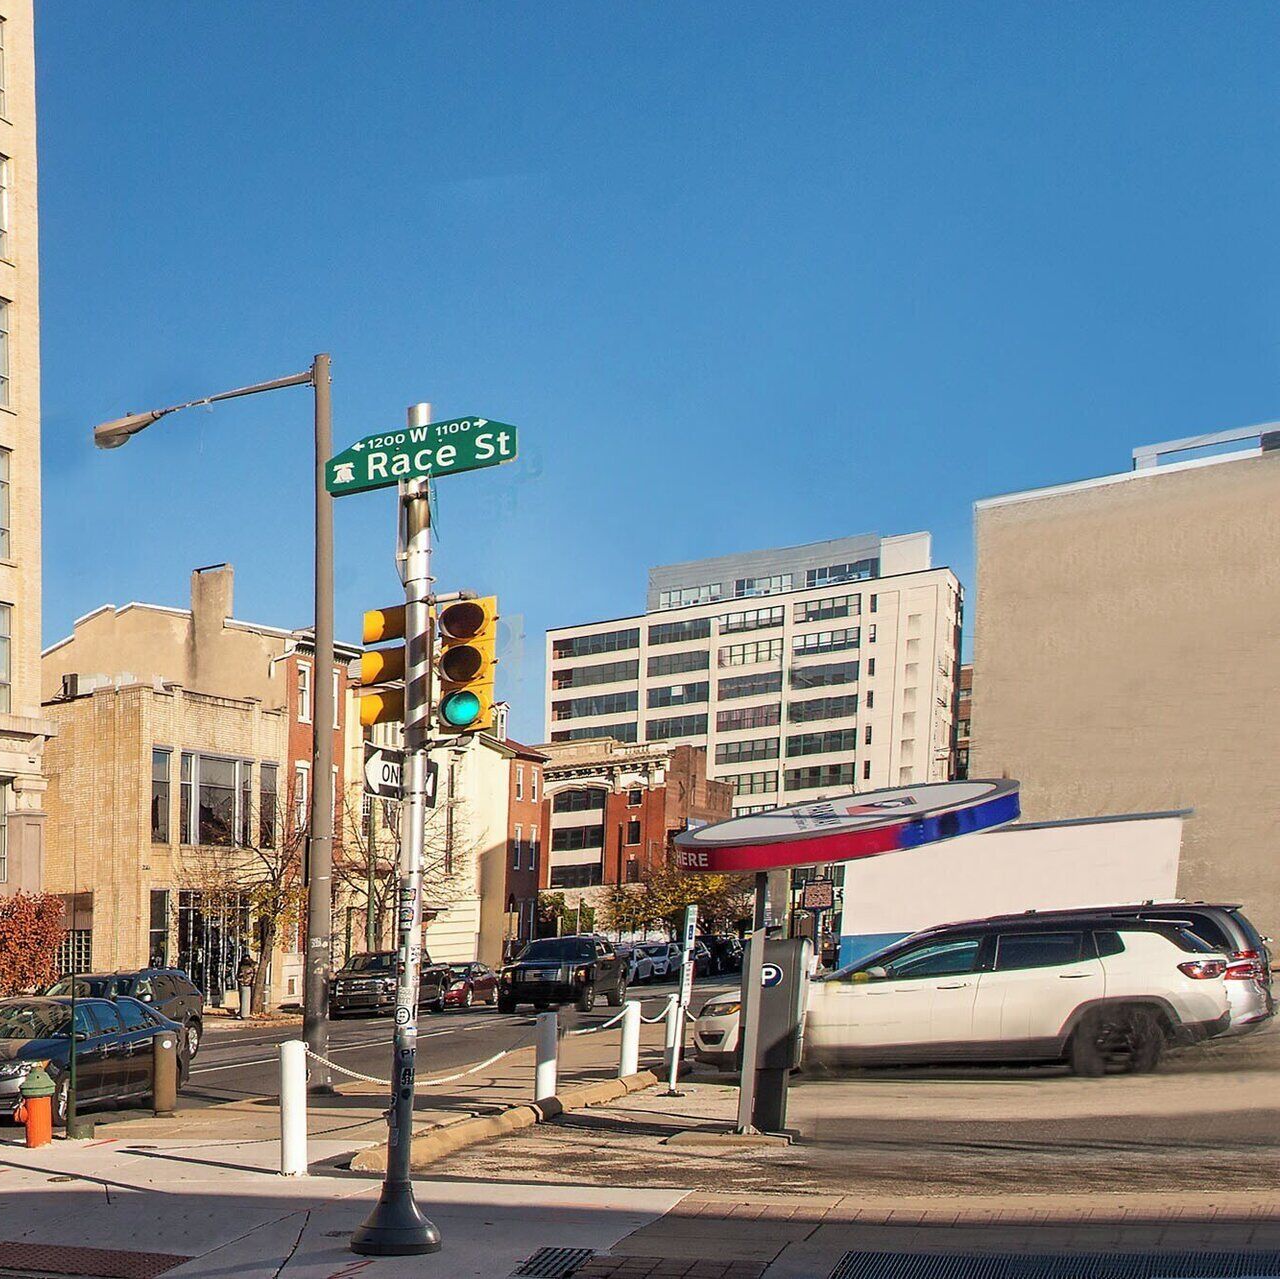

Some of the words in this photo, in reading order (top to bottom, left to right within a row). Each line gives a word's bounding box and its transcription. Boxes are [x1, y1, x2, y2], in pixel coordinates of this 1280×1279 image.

[367, 433, 405, 450] 1200
[409, 427, 428, 443] W
[435, 421, 471, 436] 1100
[367, 444, 457, 480] Race
[475, 431, 510, 460] St
[381, 764, 400, 783] ON
[676, 851, 709, 867] HERE
[762, 967, 777, 985] P
